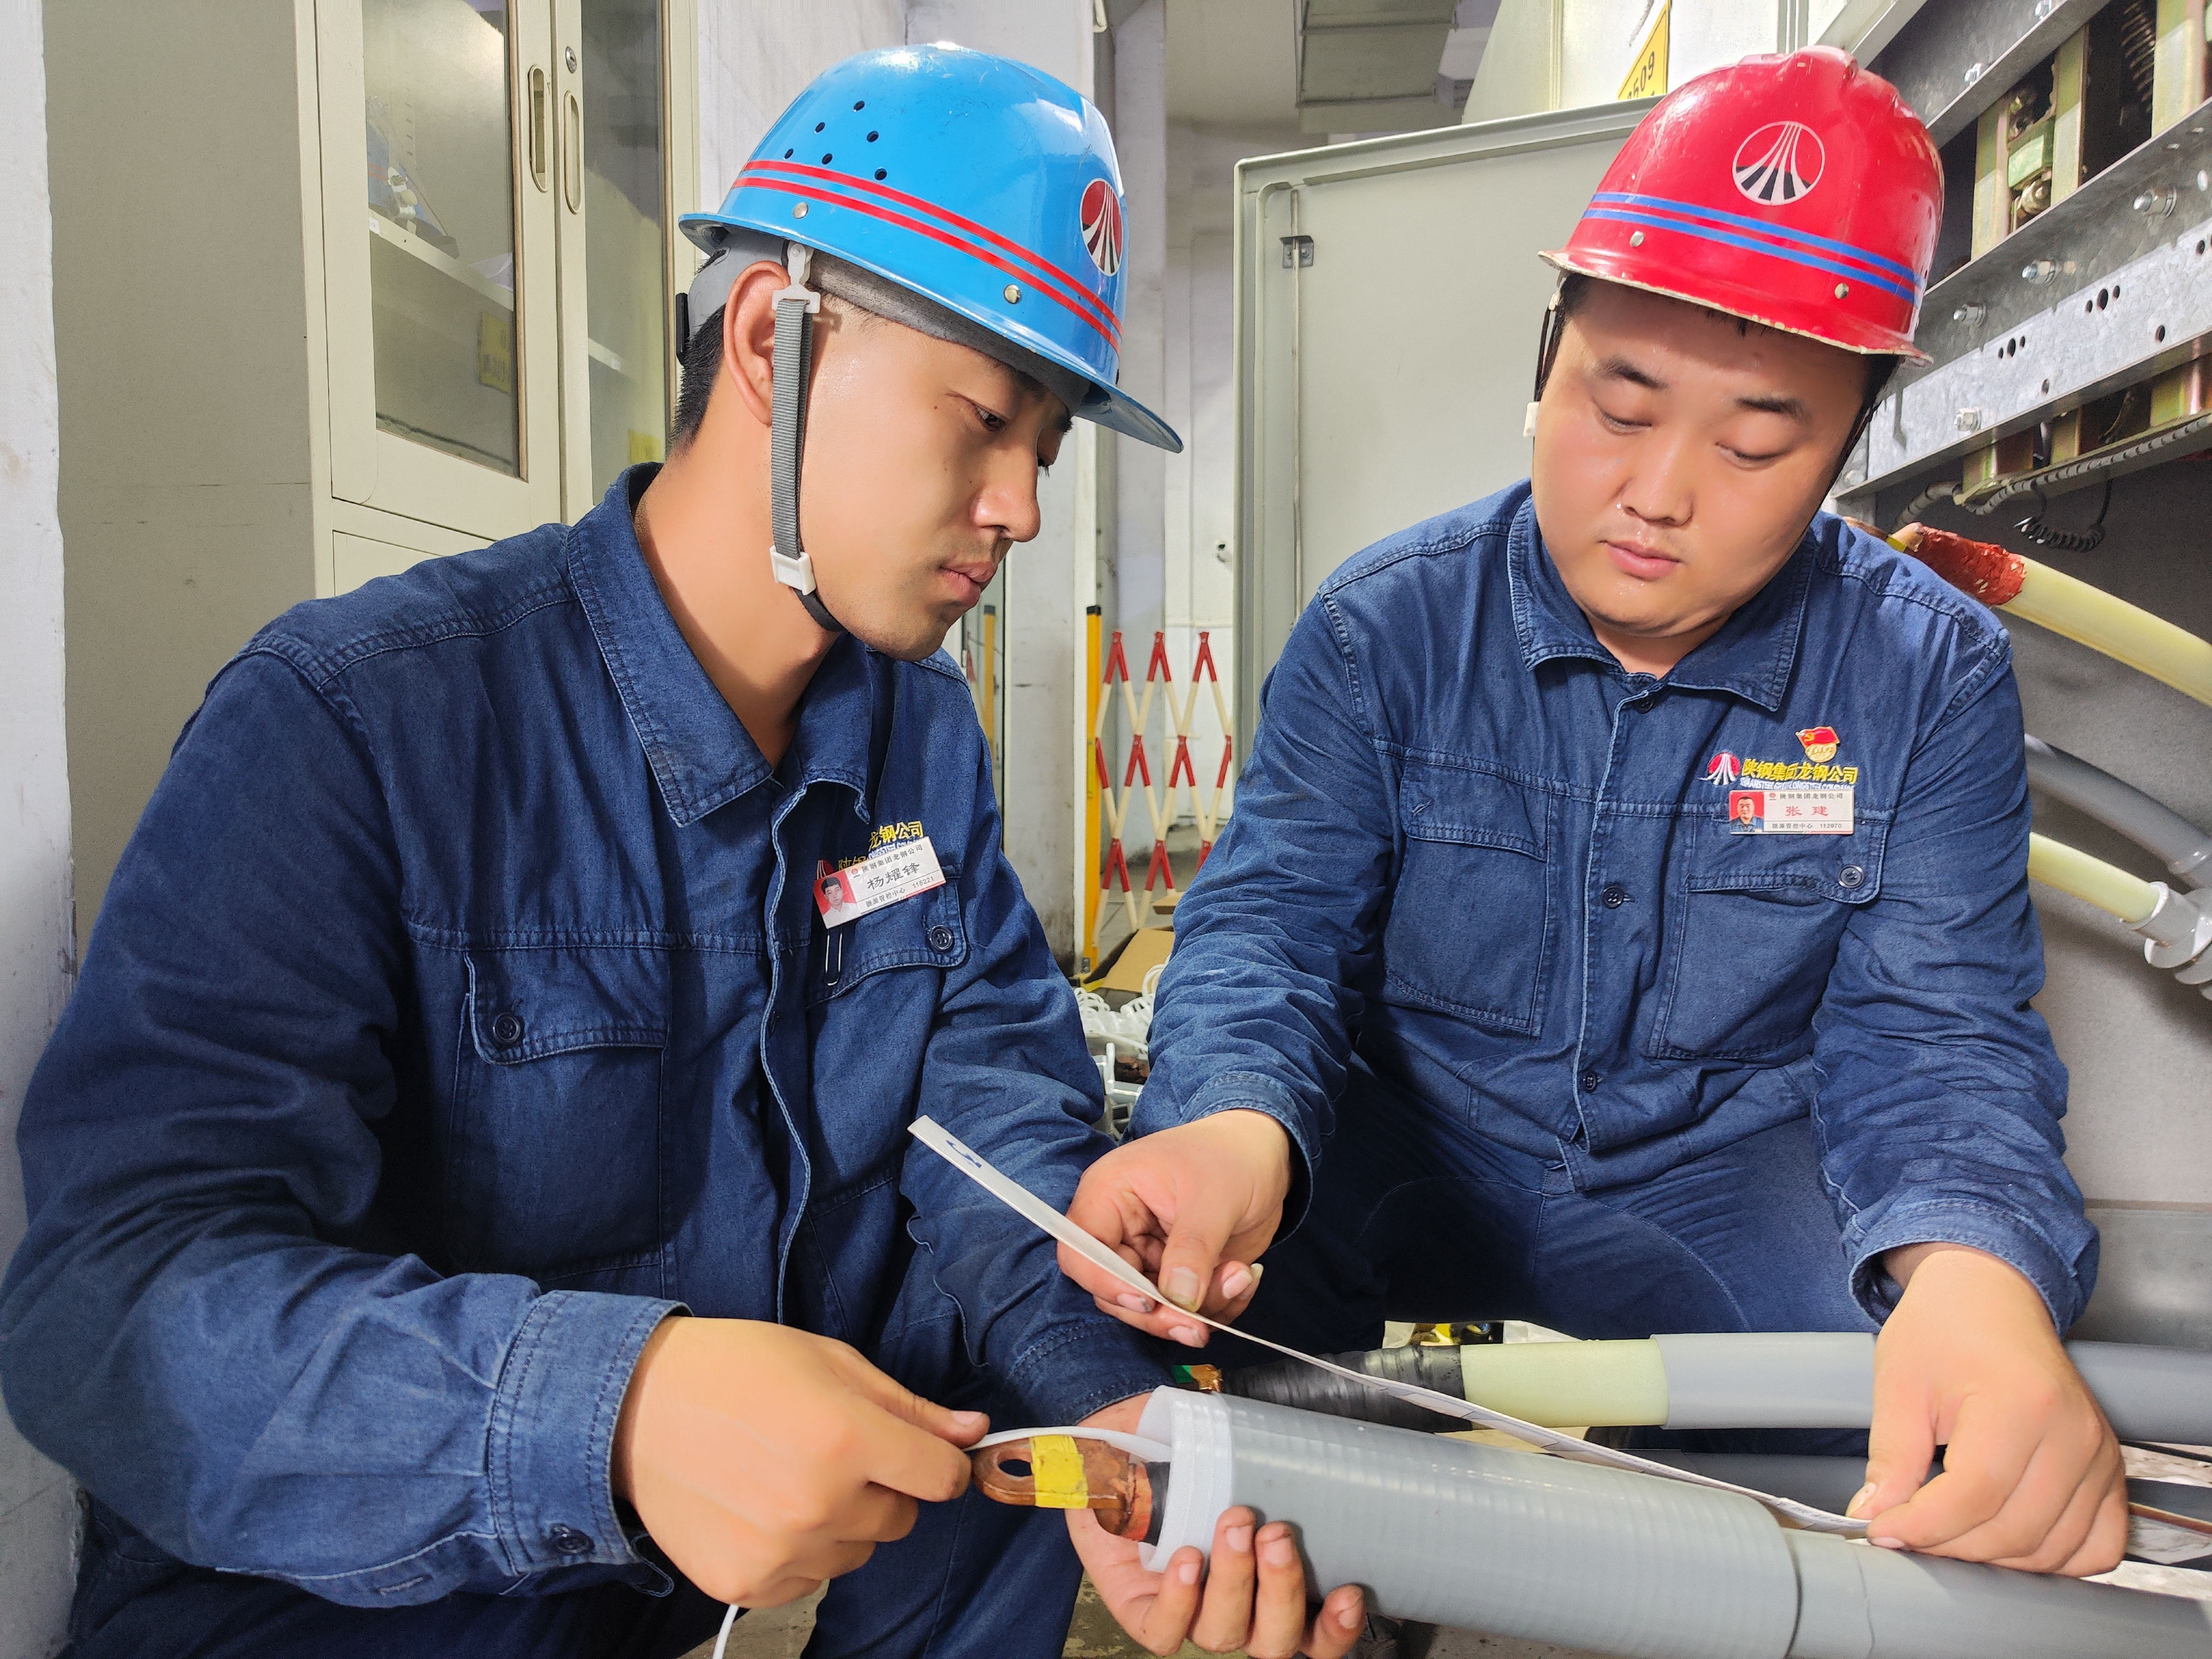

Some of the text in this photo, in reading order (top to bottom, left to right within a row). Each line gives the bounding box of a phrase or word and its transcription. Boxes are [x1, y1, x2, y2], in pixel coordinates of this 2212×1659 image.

[1742, 758, 1858, 785] 陕钢集团龙钢公司
[861, 844, 923, 873] 陕钢集团龙钢公司
[867, 862, 920, 890] 杨耀锋
[866, 876, 934, 908] 能源管控中心 115221
